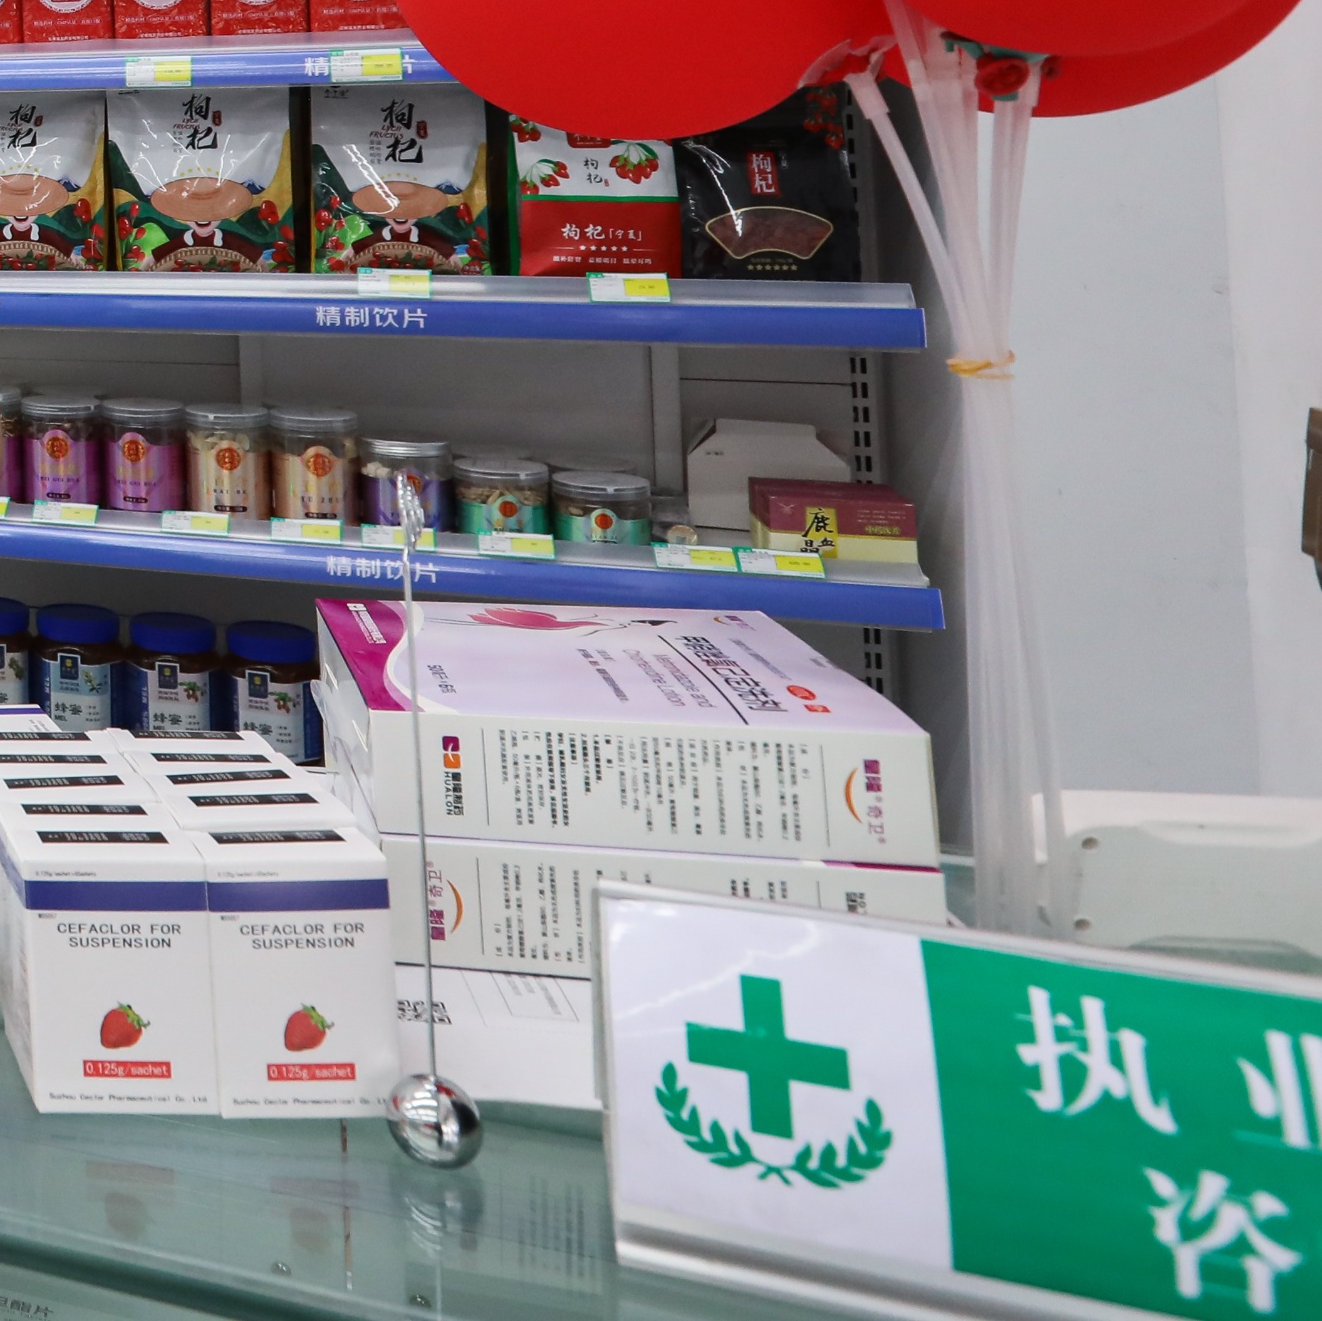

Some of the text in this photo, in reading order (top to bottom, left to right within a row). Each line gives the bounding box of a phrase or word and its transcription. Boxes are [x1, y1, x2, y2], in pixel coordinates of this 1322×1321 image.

[182, 93, 219, 150] 枸杞
[380, 98, 424, 165] 枸杞
[751, 153, 776, 194] 枸杞
[561, 223, 606, 240] 枸杞
[315, 306, 428, 330] 精制饮片
[326, 554, 438, 584] 精制饮片
[443, 771, 453, 816] HUALON
[57, 923, 182, 935] CEFACLOR FOR
[239, 922, 366, 936] CEFACLOR FOR
[68, 936, 172, 949] SUSPENSION
[252, 936, 355, 950] SUSPENSION
[85, 1062, 169, 1077] 0.125g/sachet
